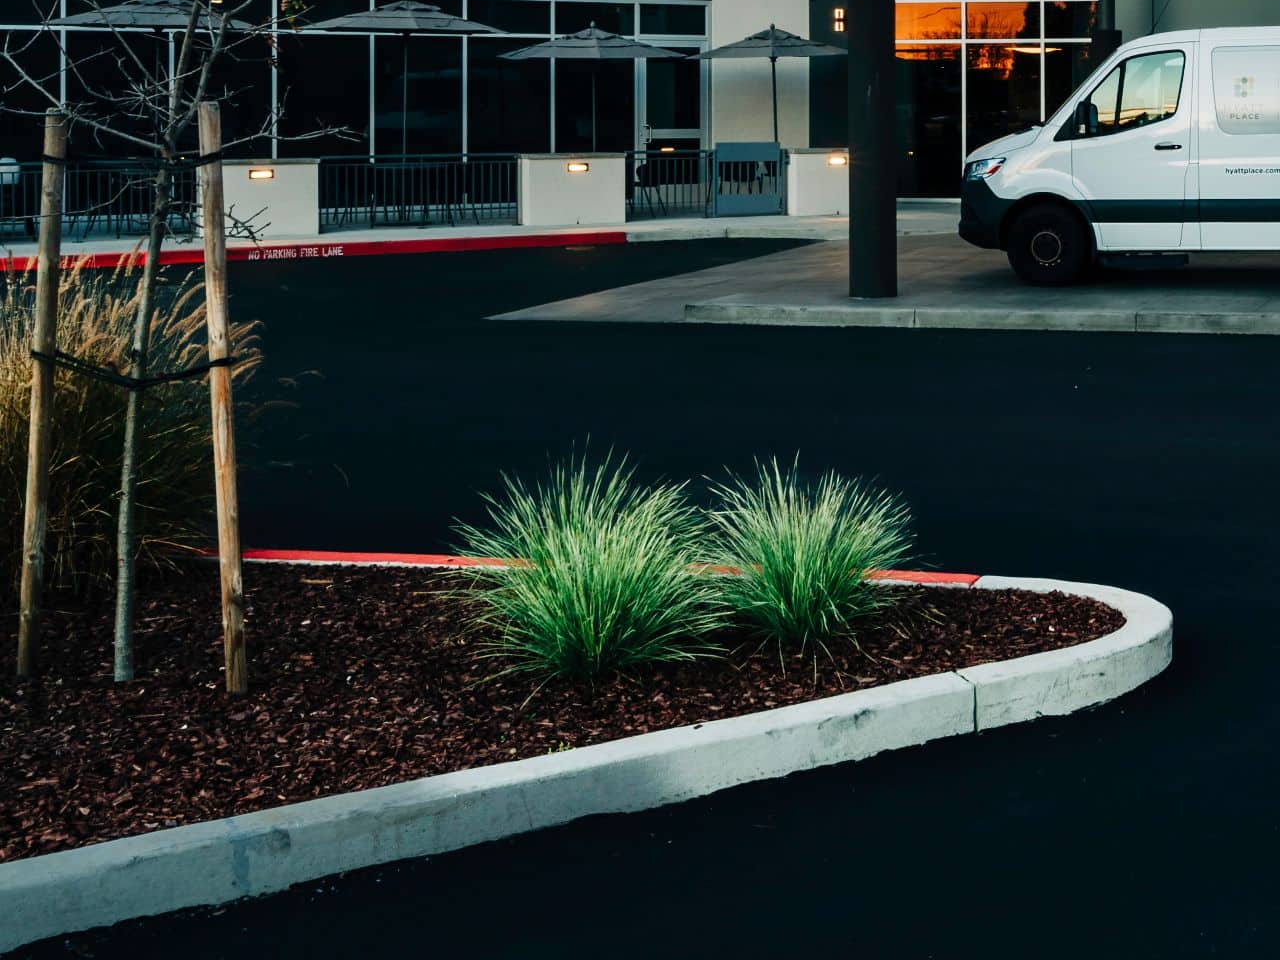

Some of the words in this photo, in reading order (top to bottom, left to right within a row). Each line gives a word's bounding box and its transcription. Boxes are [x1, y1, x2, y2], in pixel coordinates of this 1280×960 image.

[1225, 167, 1280, 175] hyattplace.com
[248, 250, 260, 260] NO
[263, 248, 297, 259] PARKING
[300, 247, 319, 257] FIRE
[322, 246, 344, 257] LANE
